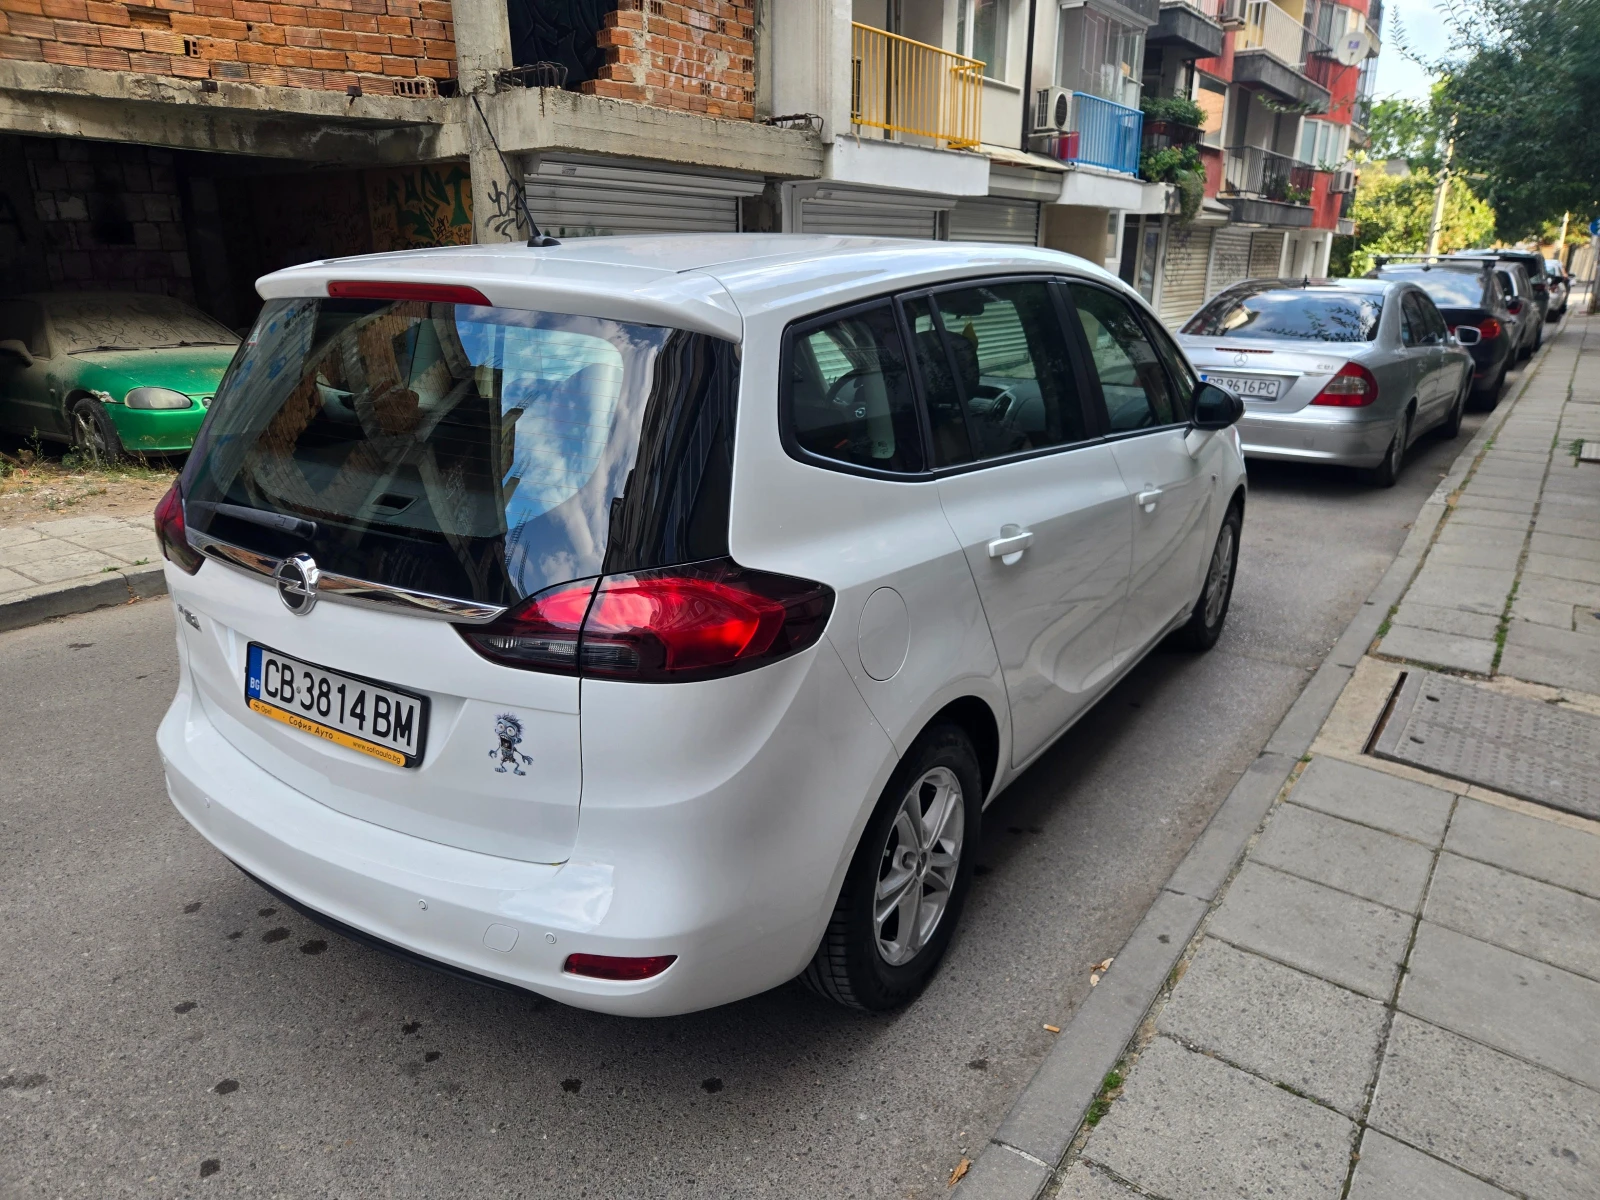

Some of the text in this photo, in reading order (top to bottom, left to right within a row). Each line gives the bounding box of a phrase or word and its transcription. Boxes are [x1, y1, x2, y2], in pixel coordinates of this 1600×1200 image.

[250, 677, 260, 690] BG
[261, 705, 272, 715] Opel
[288, 716, 333, 739] София Ауто
[352, 741, 401, 764] www.sofiaauto.bg
